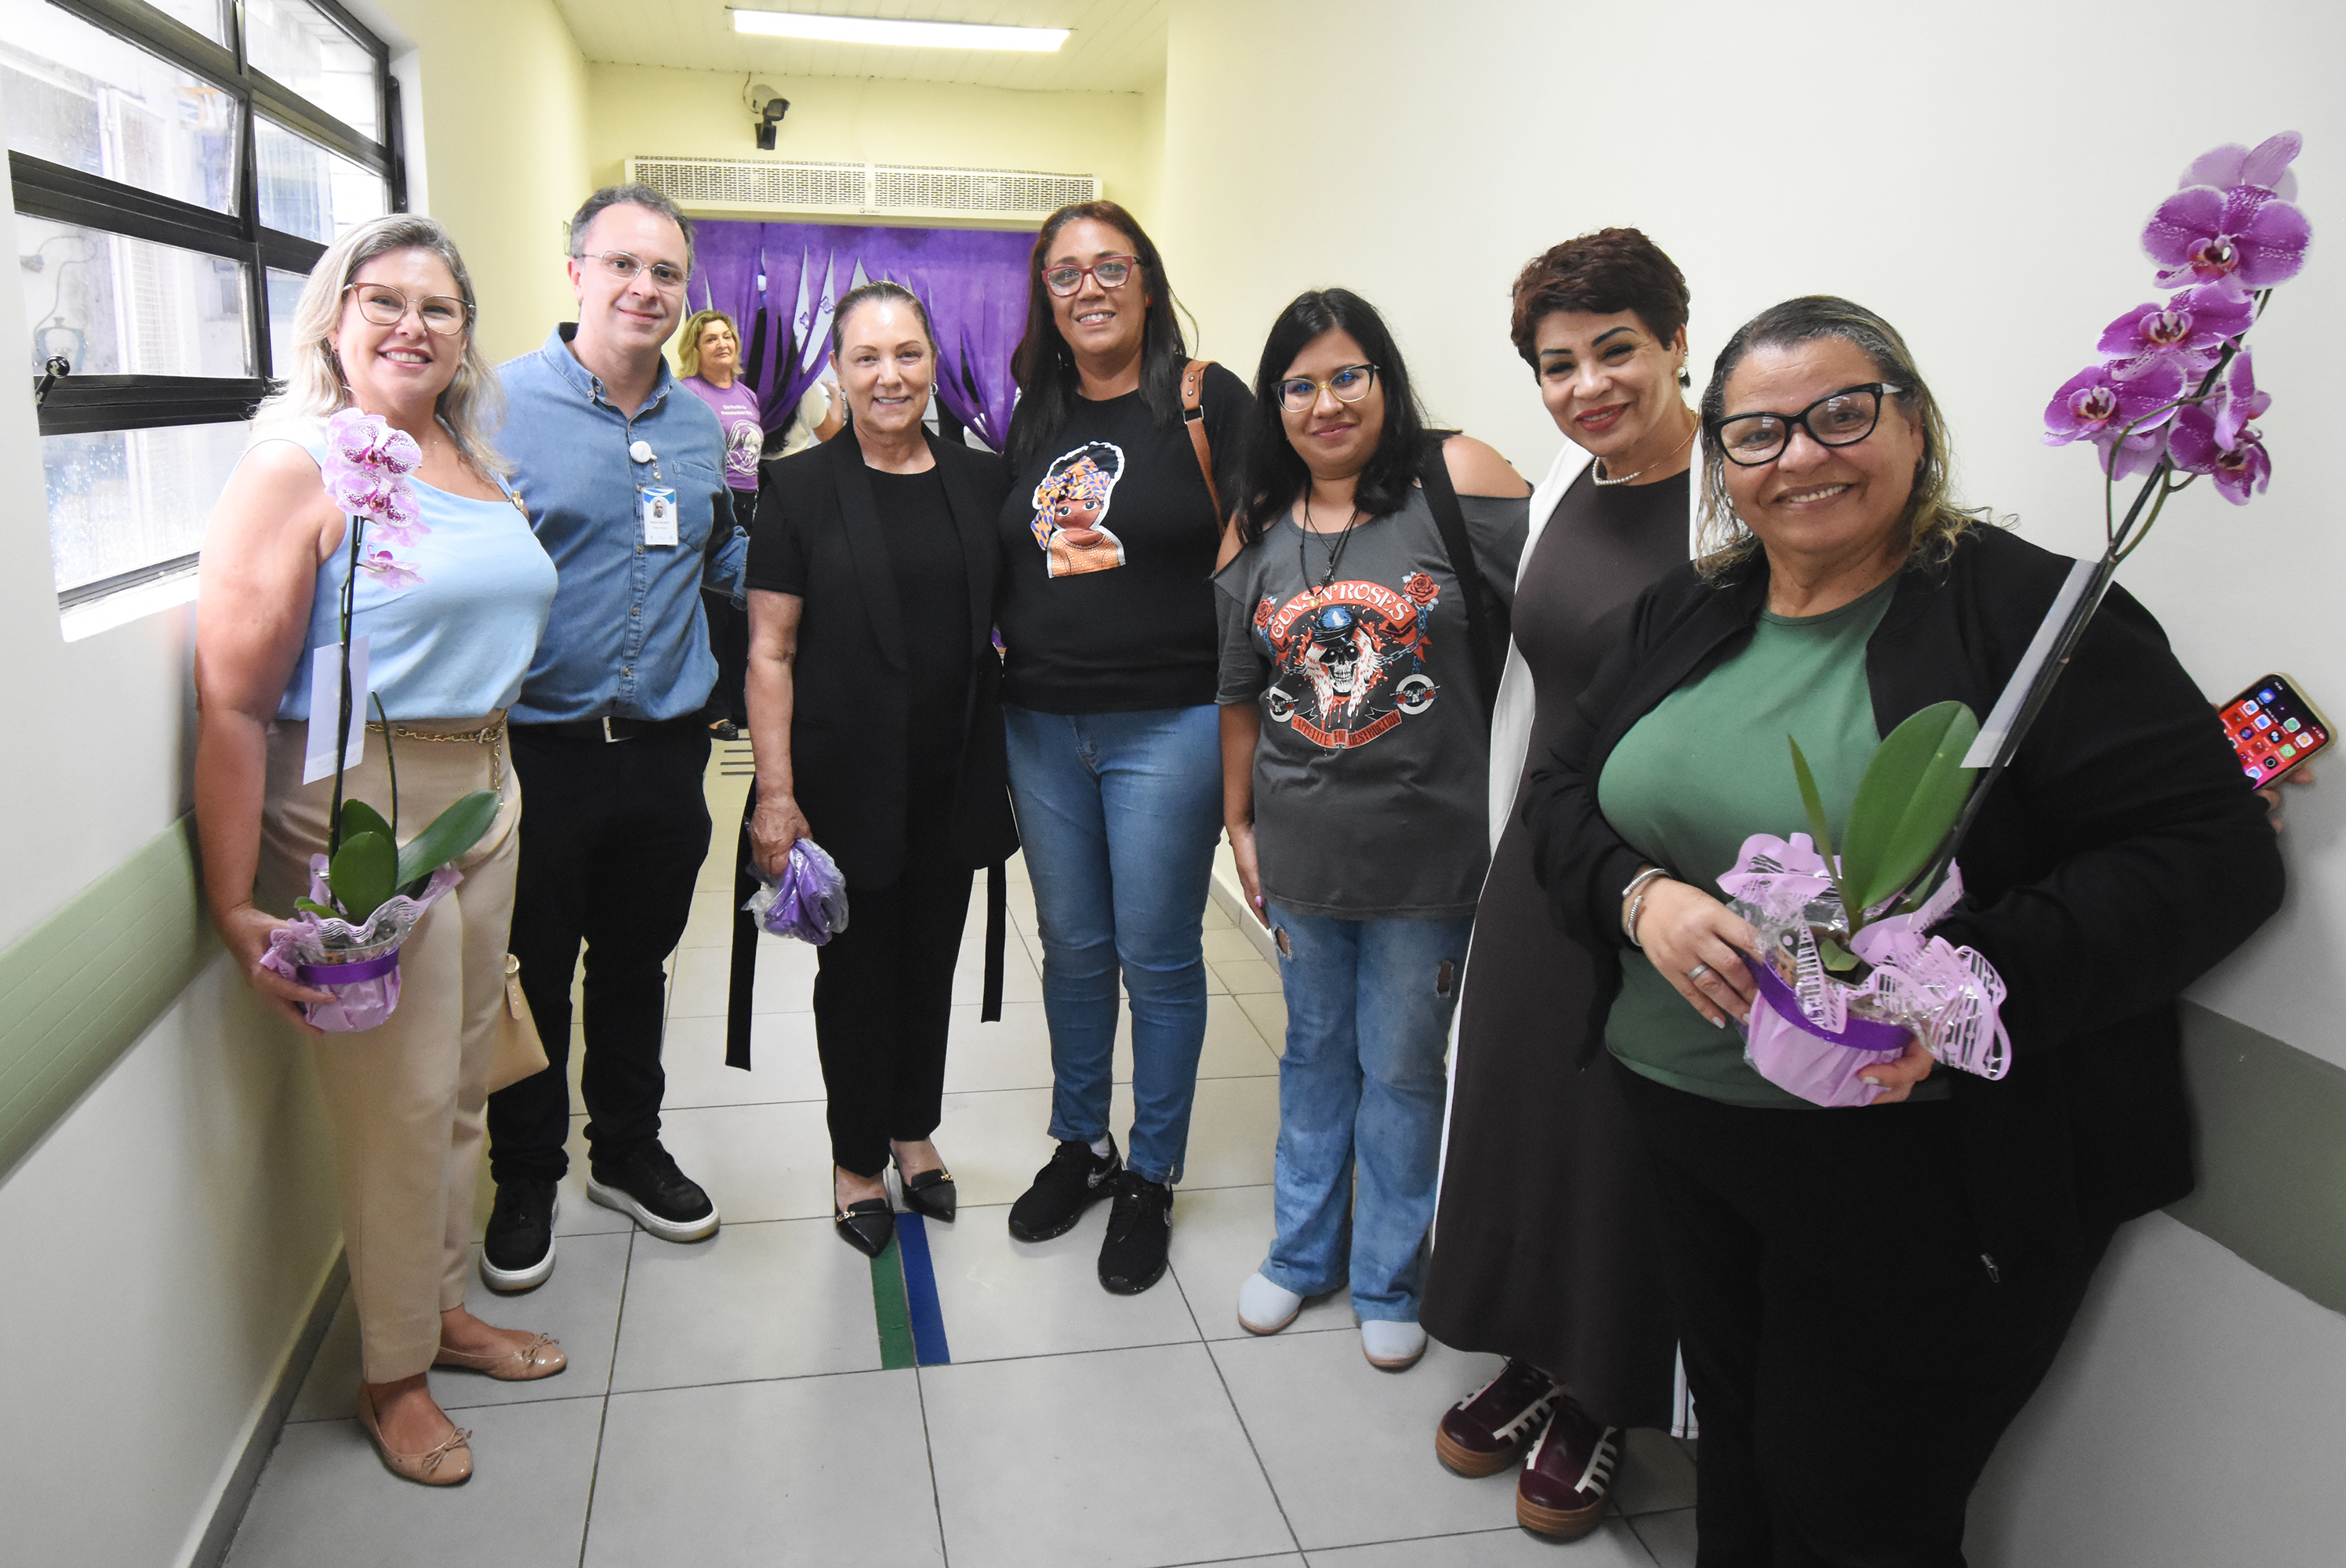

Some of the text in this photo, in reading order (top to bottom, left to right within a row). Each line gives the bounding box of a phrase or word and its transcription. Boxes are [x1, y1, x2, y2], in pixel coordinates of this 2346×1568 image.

[1272, 592, 1317, 639] GUNS
[1339, 583, 1411, 621] ROSES
[1298, 718, 1330, 746] APPETITE
[1349, 712, 1401, 746] DESTRUCTION
